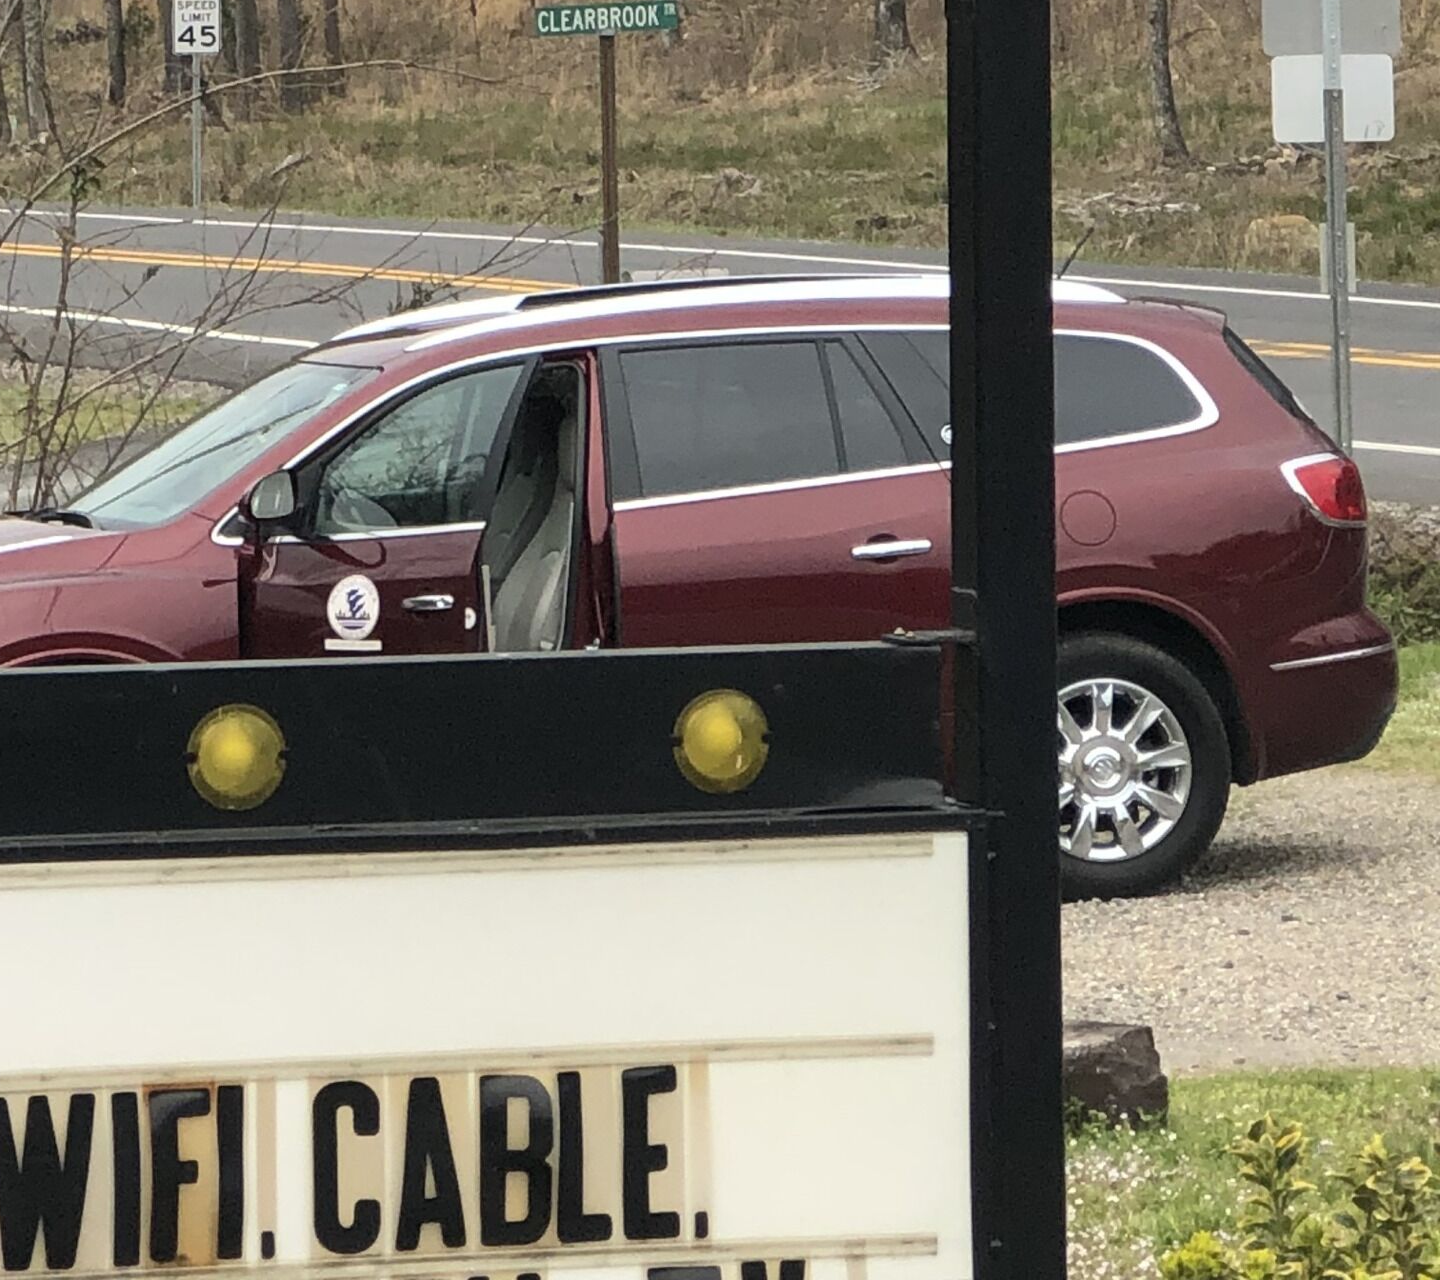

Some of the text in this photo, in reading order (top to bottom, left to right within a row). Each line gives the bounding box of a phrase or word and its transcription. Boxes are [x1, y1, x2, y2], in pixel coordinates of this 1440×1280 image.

[177, 0, 217, 10] SPEED
[181, 13, 211, 22] LIMIT
[537, 4, 660, 33] CLEARBROOK
[177, 25, 217, 47] 45
[312, 1065, 710, 1255] CABLE.
